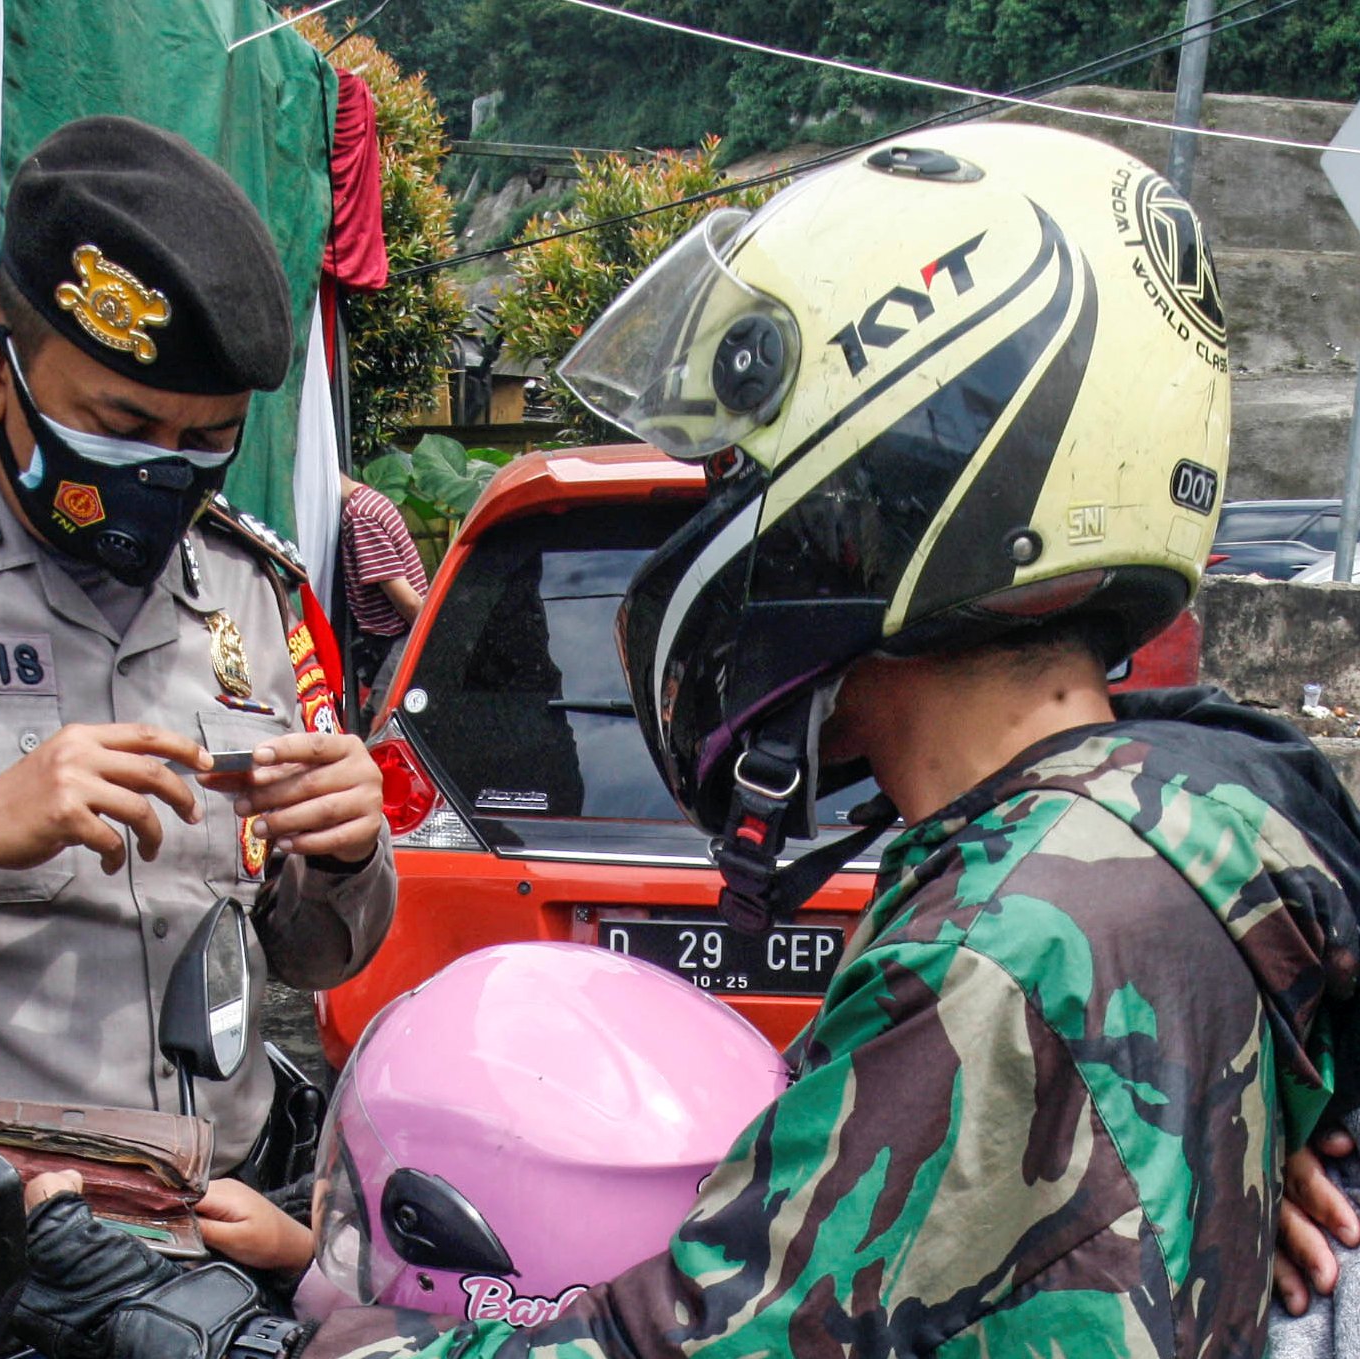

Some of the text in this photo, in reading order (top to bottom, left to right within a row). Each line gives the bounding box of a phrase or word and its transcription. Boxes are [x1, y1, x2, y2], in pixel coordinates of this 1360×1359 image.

[1111, 168, 1133, 233] WORLD
[827, 229, 989, 378] KYT
[1131, 256, 1191, 342] WORLD
[1176, 466, 1216, 508] DOT
[51, 510, 77, 534] TNI
[1068, 503, 1106, 540] SNI
[677, 931, 723, 969] 29
[766, 933, 836, 973] CEP
